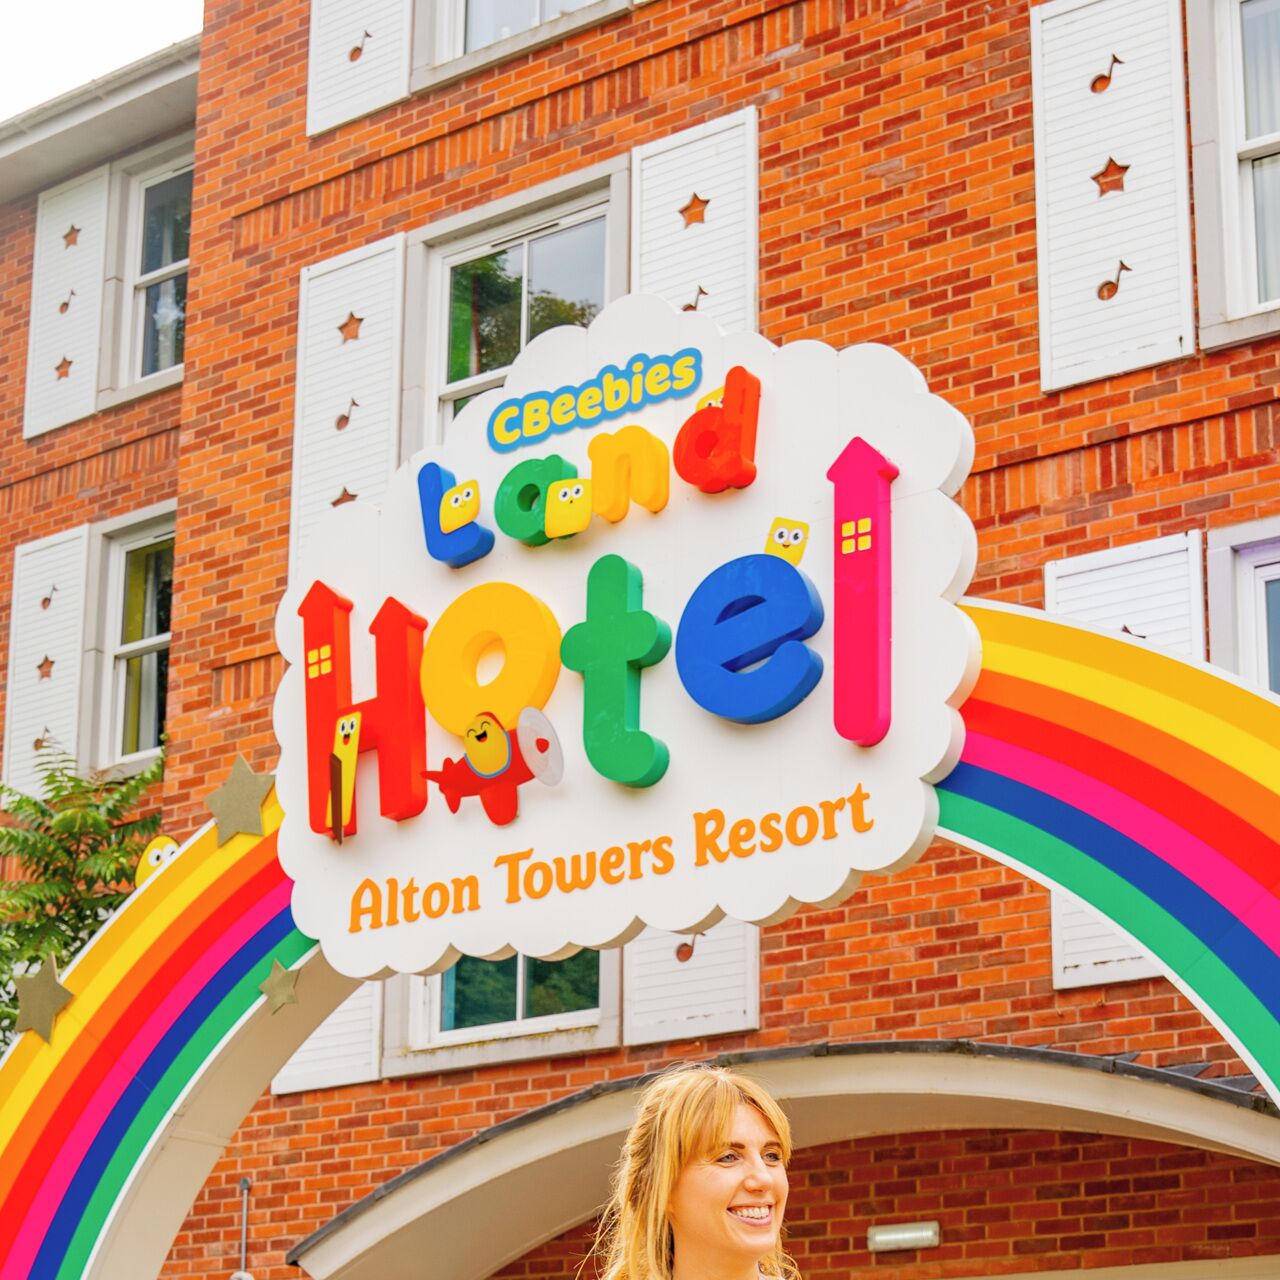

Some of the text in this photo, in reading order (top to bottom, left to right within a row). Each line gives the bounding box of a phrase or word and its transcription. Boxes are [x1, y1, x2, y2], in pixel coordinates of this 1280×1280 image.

[417, 366, 762, 568] Land
[490, 352, 699, 448] CBeebies
[297, 436, 900, 836] Hotel
[348, 784, 875, 932] Alton Towers Resort
